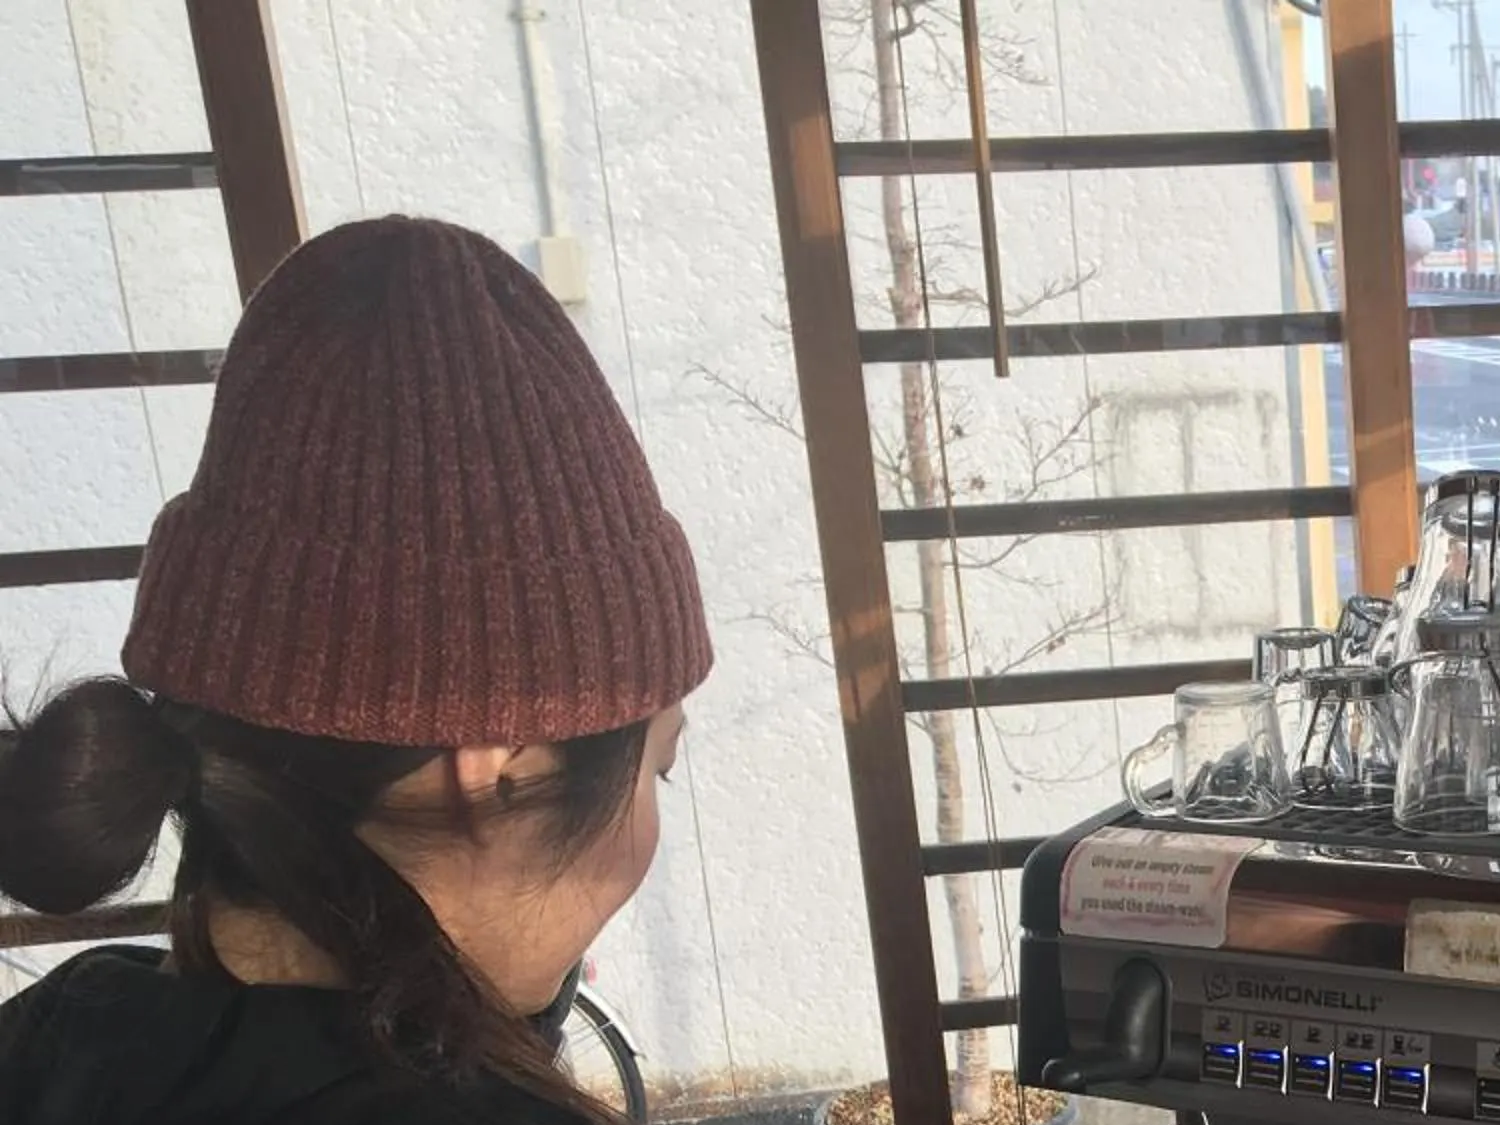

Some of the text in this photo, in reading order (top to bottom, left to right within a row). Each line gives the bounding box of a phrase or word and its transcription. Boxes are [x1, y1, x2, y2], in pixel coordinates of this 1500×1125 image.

[1149, 860, 1180, 875] empty
[1101, 897, 1124, 911] used
[1125, 898, 1143, 912] the
[1236, 980, 1377, 1012] SIMONELLI
